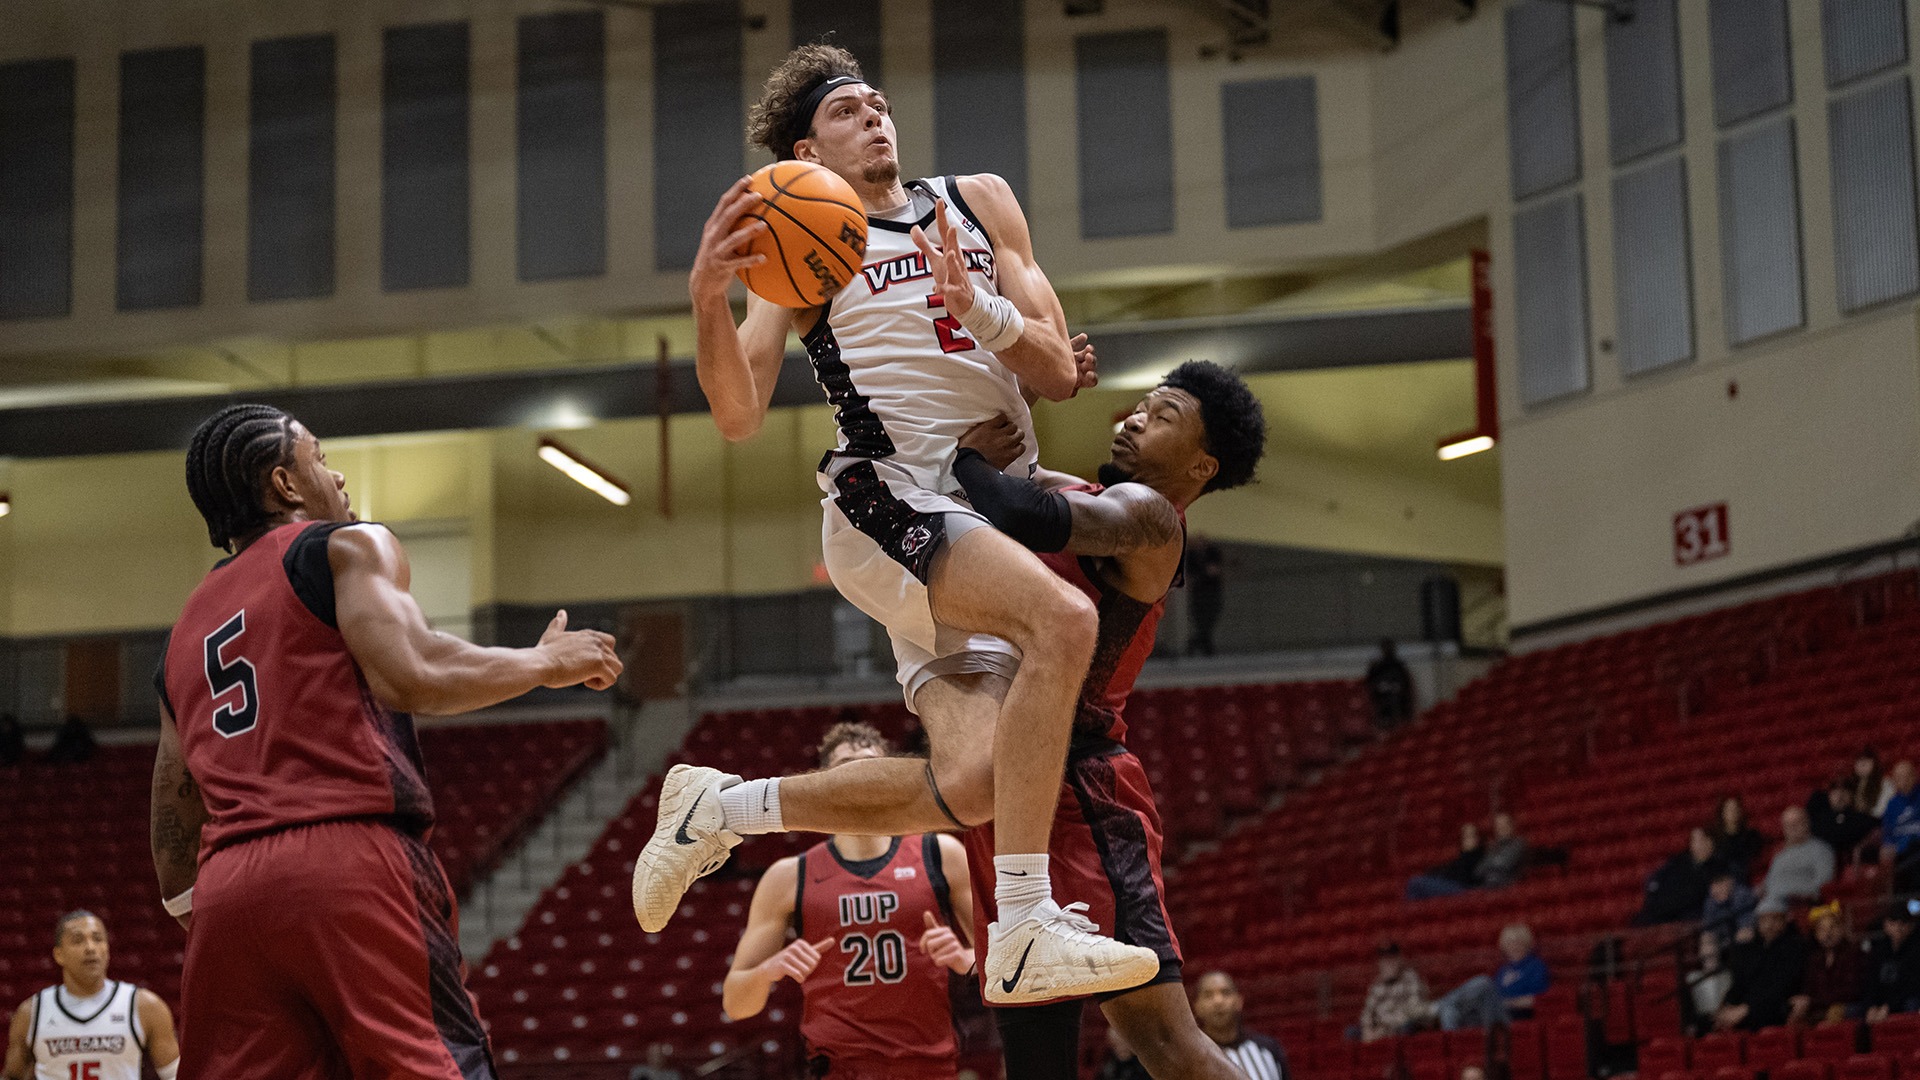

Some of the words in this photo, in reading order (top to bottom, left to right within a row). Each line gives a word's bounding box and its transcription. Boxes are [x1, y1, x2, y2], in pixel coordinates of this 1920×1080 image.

[861, 249, 995, 295] VULNS
[926, 294, 975, 354] 2
[1679, 509, 1726, 560] 31
[204, 608, 259, 739] 5
[839, 891, 899, 927] IUP
[840, 930, 907, 986] 20
